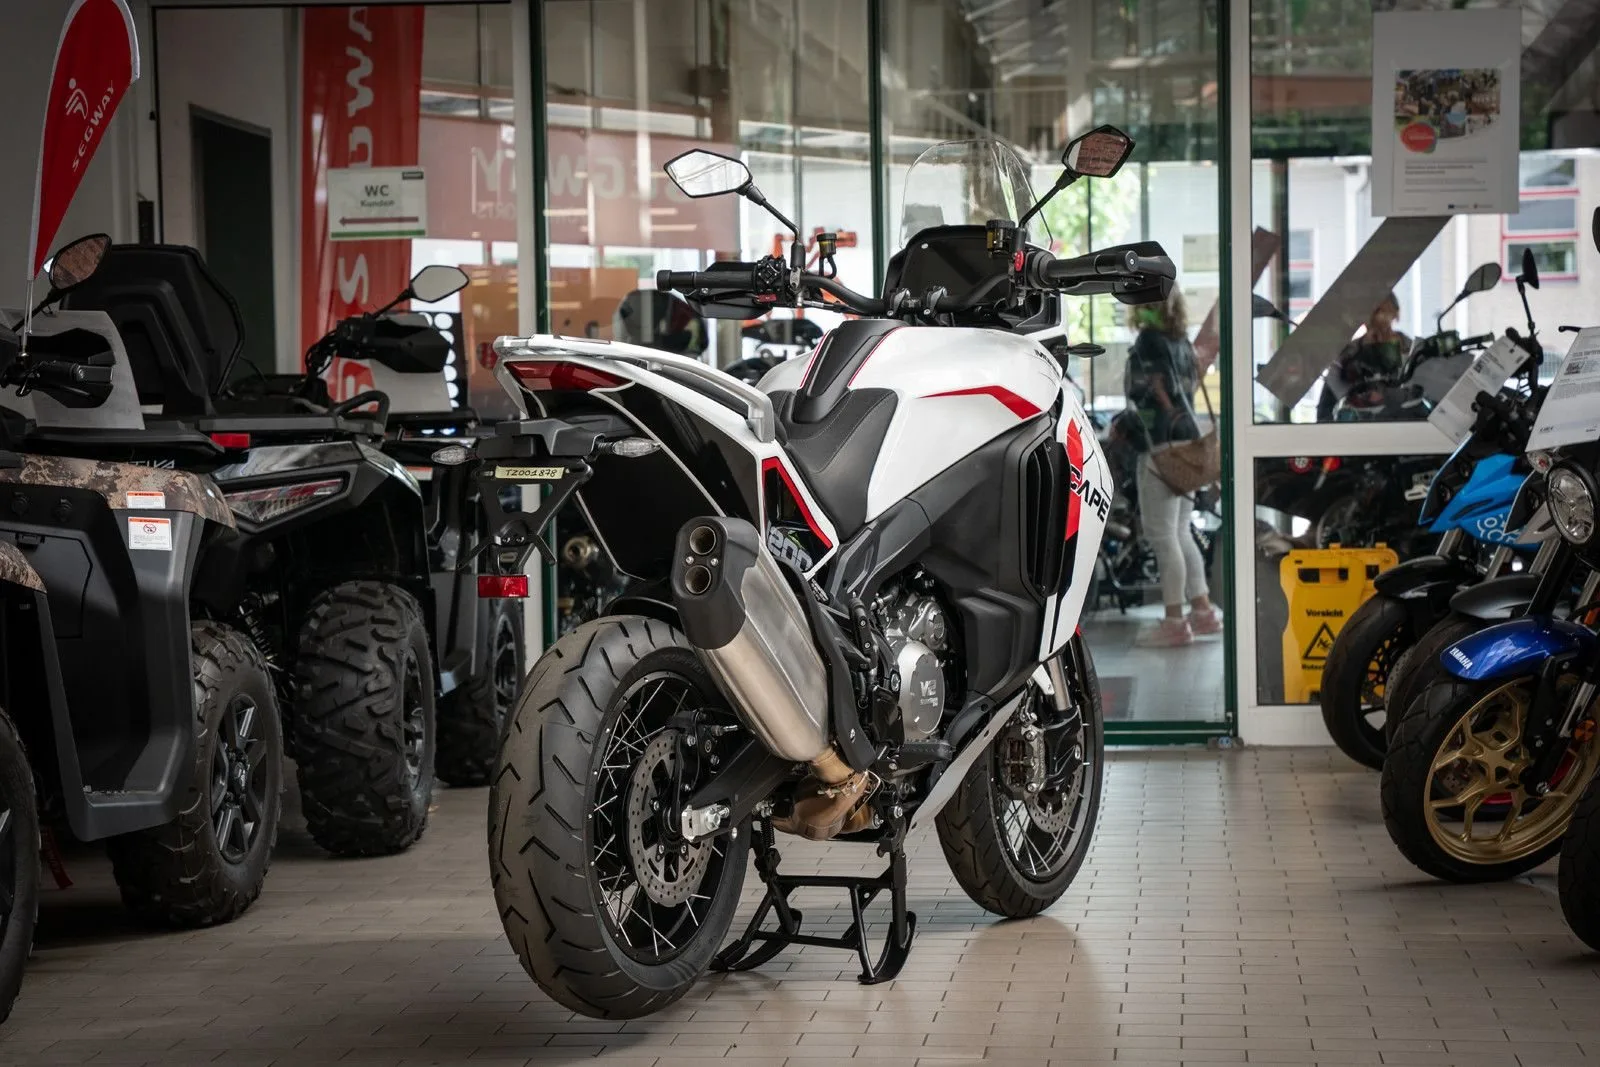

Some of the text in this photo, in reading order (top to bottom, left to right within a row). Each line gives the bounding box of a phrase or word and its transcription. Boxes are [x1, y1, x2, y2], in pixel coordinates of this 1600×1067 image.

[72, 80, 114, 172] SEGWAY
[364, 184, 389, 197] WC
[505, 468, 558, 478] TZ001878
[1305, 608, 1344, 617] Vorsicht
[1449, 646, 1473, 670] YAMAHA
